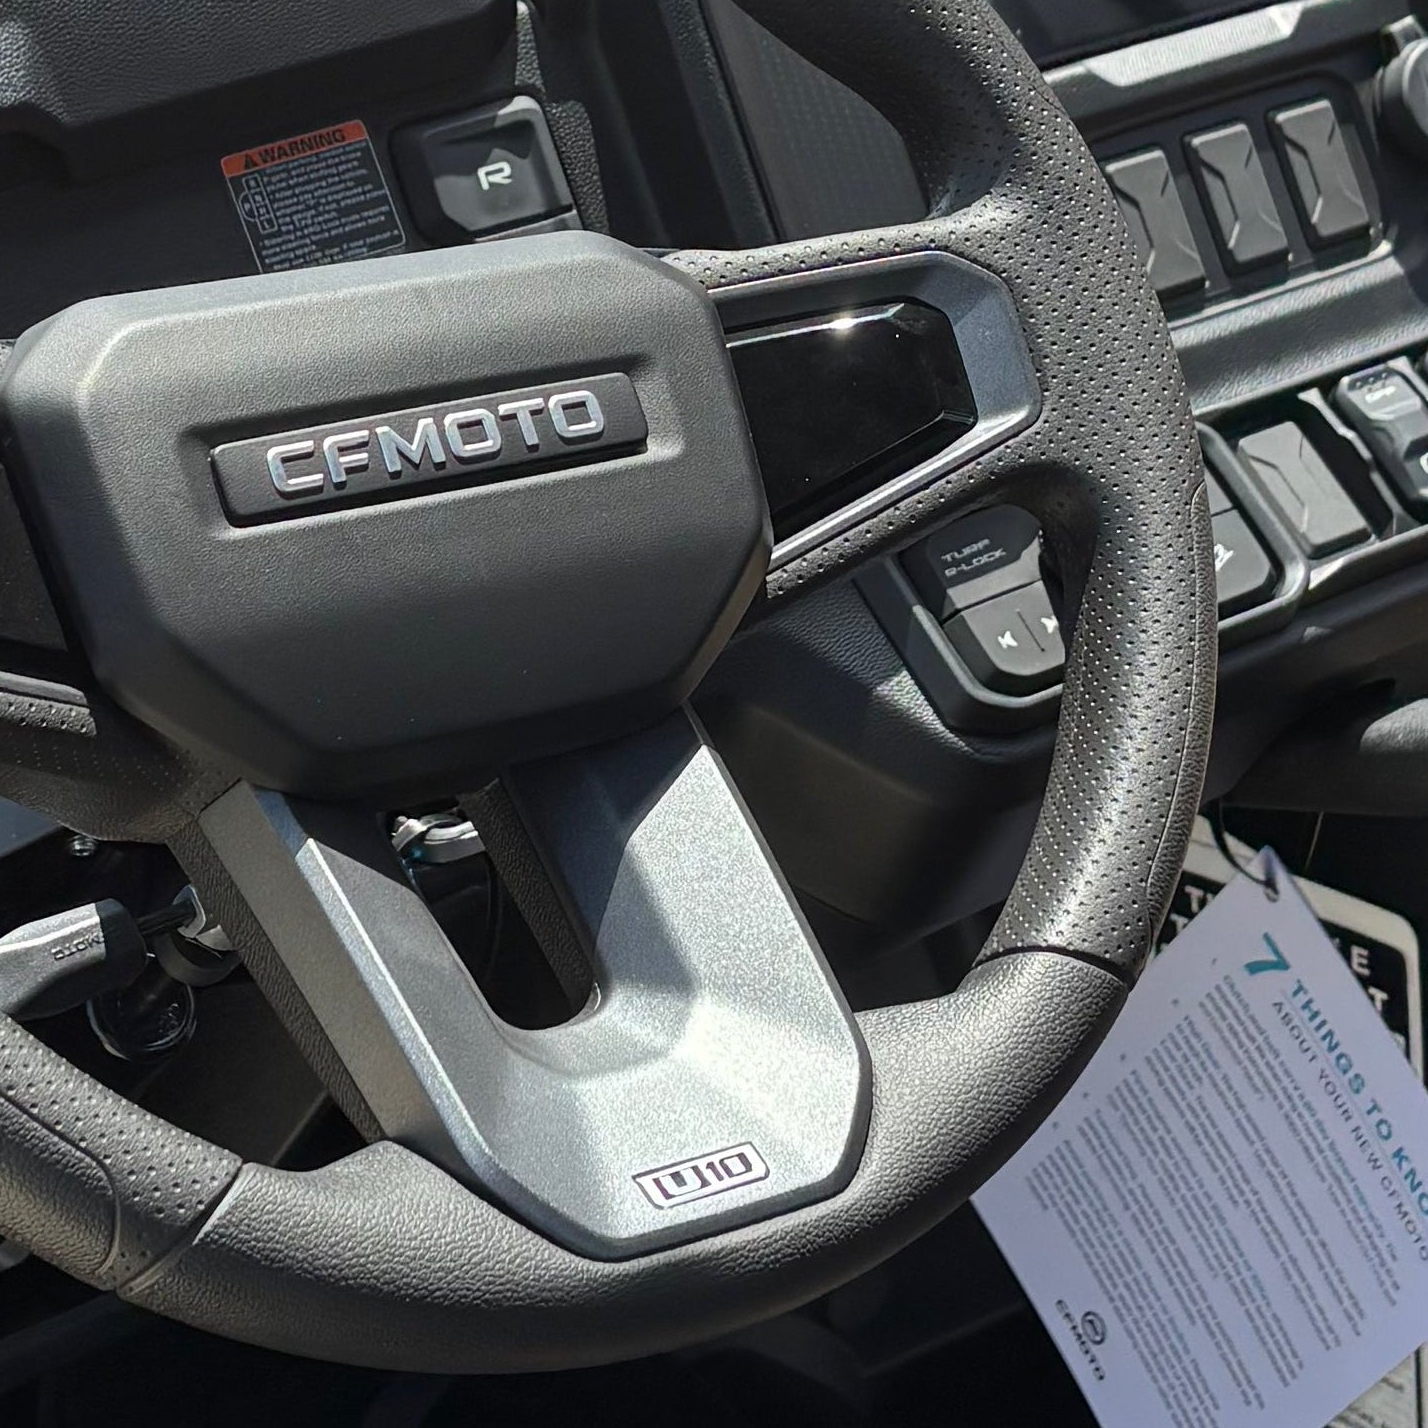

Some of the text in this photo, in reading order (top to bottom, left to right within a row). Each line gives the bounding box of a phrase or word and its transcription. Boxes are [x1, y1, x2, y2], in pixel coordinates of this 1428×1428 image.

[258, 128, 346, 163] WARNING
[477, 161, 513, 190] R
[266, 389, 605, 493] CFMOTO
[1244, 931, 1291, 976] 7
[1290, 978, 1366, 1095] THINGS
[1365, 1098, 1394, 1142] TO
[1272, 1000, 1318, 1063] ABOUT
[1318, 1068, 1353, 1123] YOUR
[1350, 1125, 1383, 1172] NEW
[652, 1152, 753, 1200] U10
